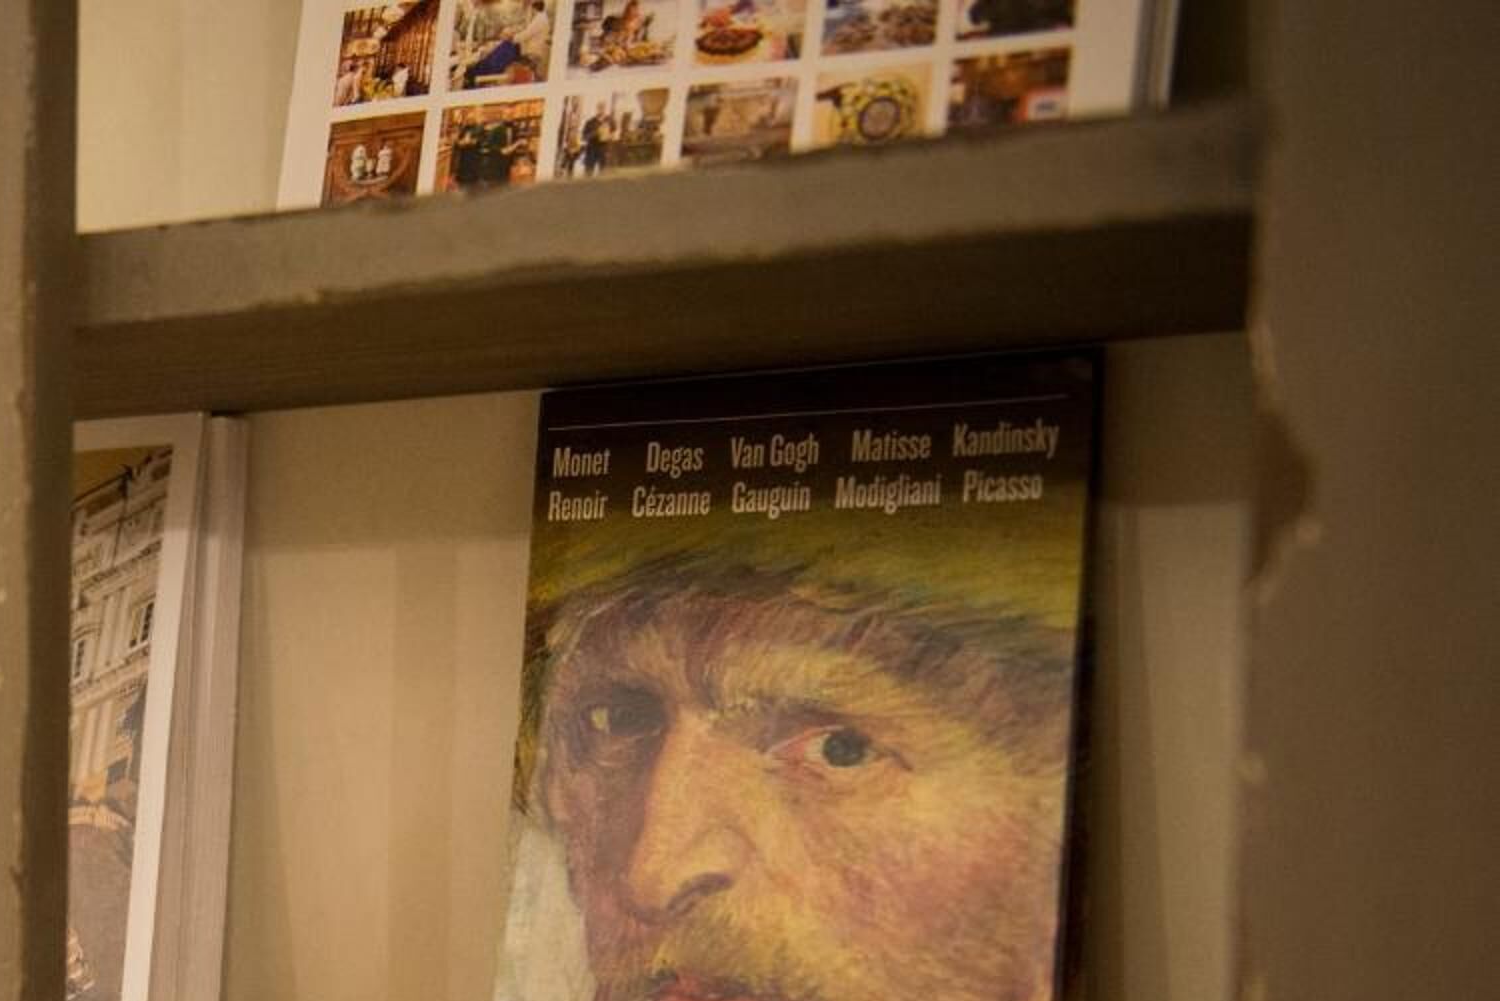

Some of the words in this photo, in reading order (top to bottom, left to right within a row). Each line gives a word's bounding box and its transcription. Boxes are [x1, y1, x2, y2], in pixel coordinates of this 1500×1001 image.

[553, 446, 610, 477] Monet
[646, 441, 704, 478] Degas
[731, 436, 764, 469] Van
[770, 432, 819, 472] Gogh
[852, 428, 931, 463] Matisse
[952, 418, 1059, 460] Kandinsky
[548, 490, 608, 521] Renoir
[632, 486, 711, 518] Cézanne
[732, 481, 811, 519] Gauguin
[835, 474, 941, 516] Modigliani
[963, 469, 1042, 503] Picasso
